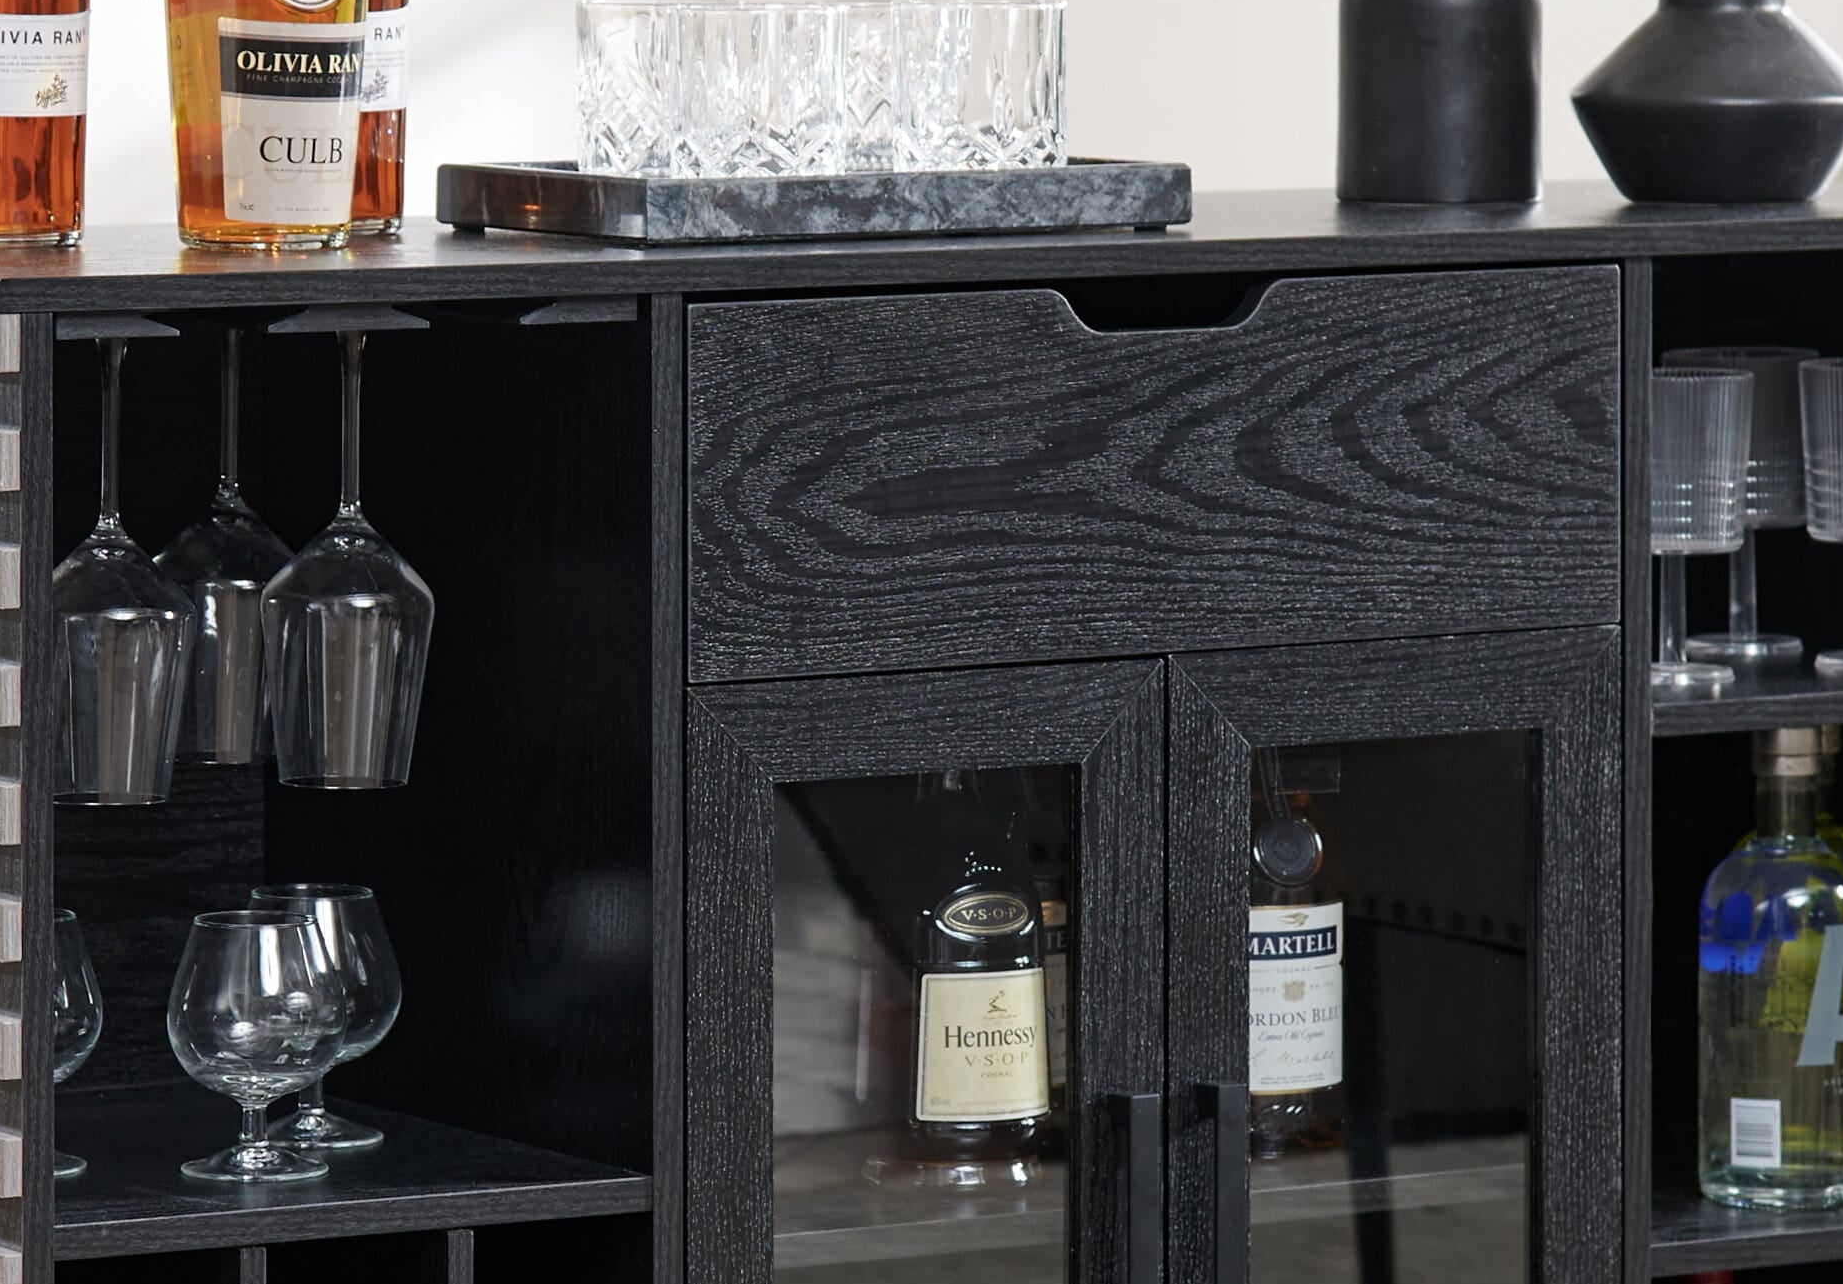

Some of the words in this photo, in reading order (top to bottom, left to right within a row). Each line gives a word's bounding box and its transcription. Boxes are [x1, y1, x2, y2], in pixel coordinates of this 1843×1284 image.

[237, 50, 323, 74] OLIVIA
[328, 52, 361, 74] RAN
[246, 73, 268, 83] FINE
[273, 75, 325, 84] CHAMPAGNE
[259, 135, 343, 164] CULB
[944, 1025, 1038, 1048] Hennessy
